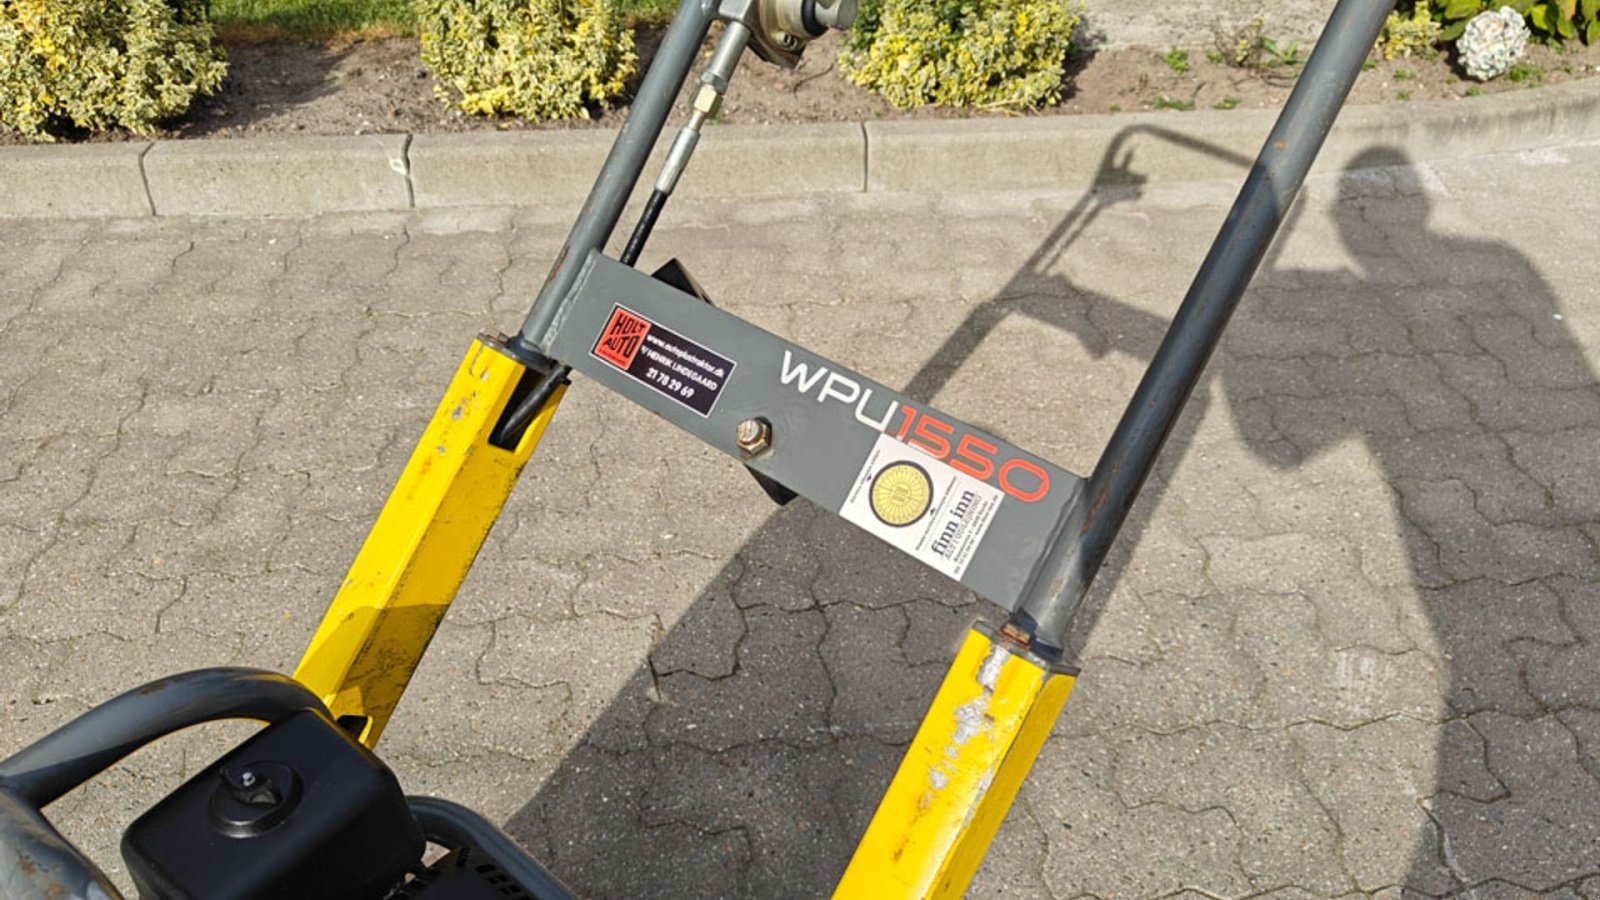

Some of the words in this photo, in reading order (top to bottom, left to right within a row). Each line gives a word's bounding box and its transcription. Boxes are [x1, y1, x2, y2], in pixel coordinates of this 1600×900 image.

[609, 313, 646, 336] HOLT
[603, 336, 640, 358] AUTO
[645, 367, 659, 380] 21
[656, 372, 670, 386] 78
[668, 379, 682, 392] 29
[680, 386, 695, 399] 69
[671, 362, 718, 391] LINDEGAARD
[930, 519, 959, 556] finn
[949, 489, 975, 518] inn
